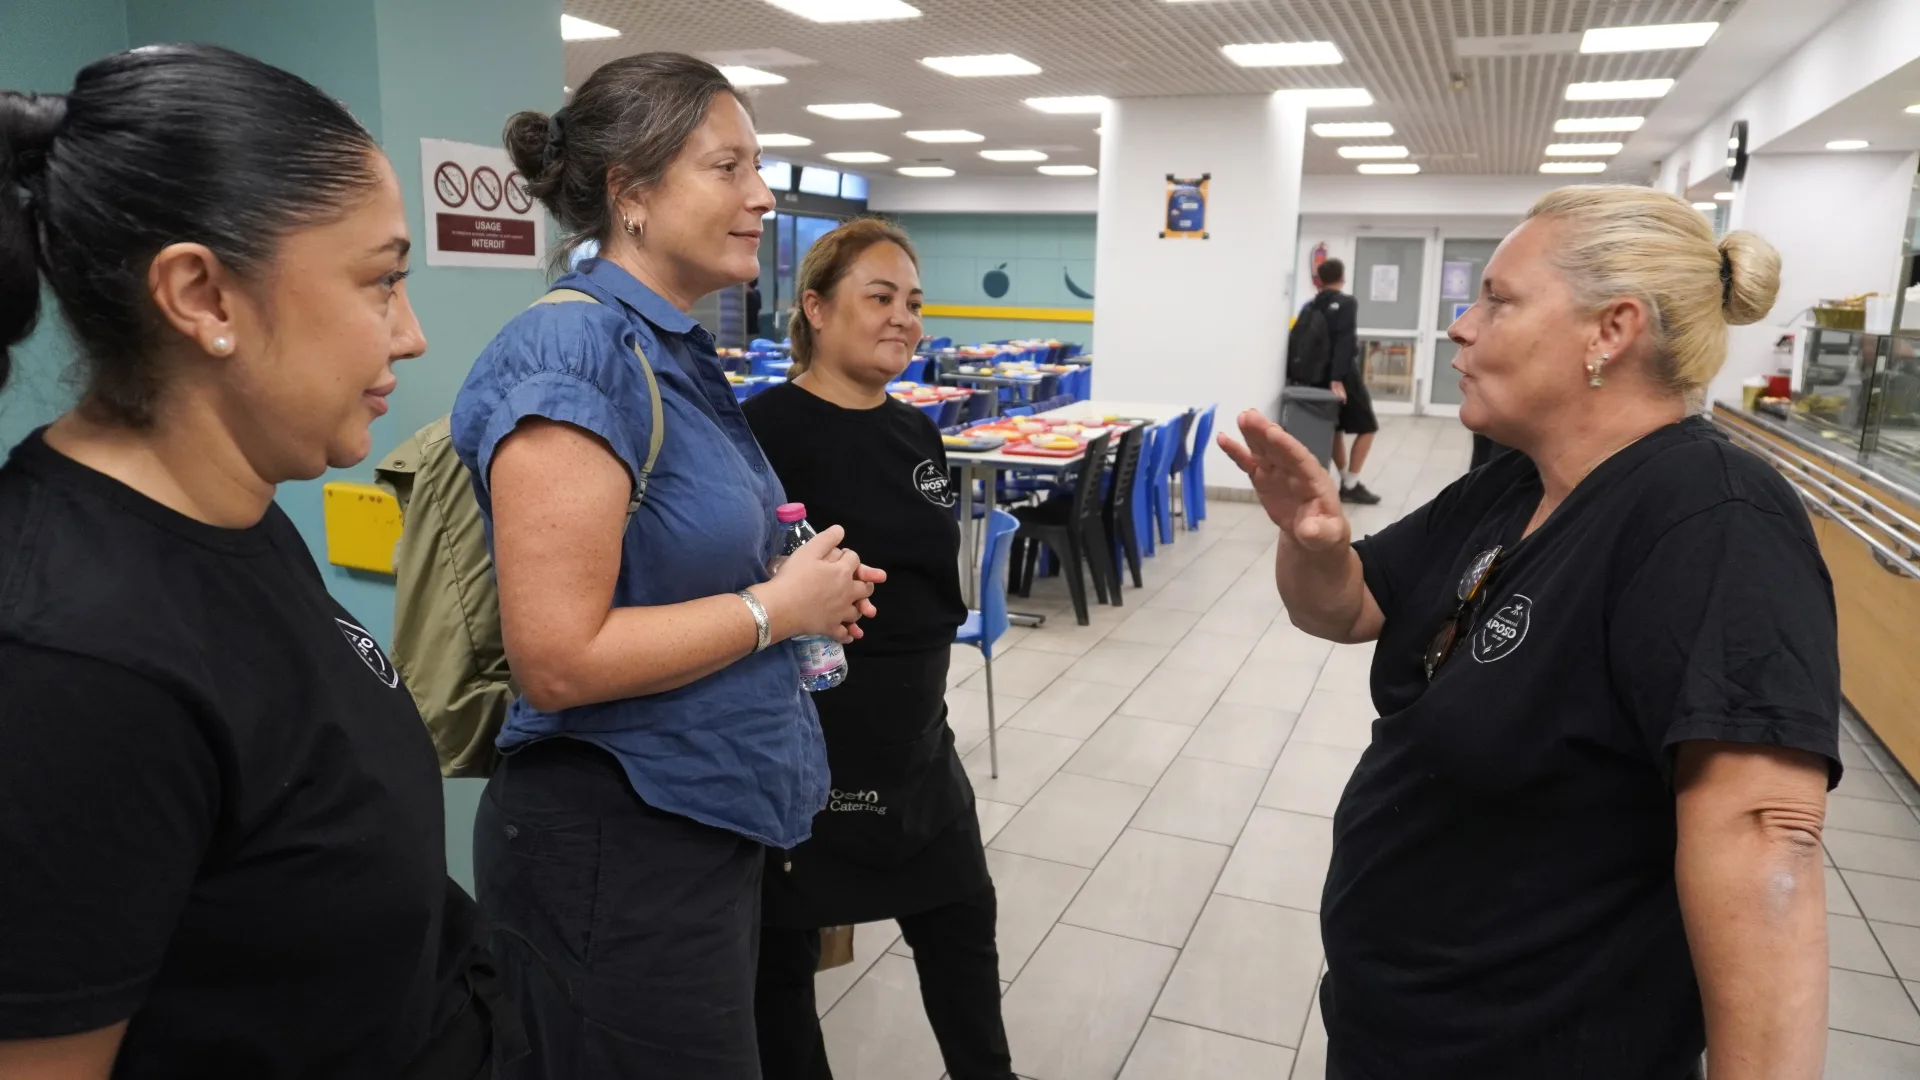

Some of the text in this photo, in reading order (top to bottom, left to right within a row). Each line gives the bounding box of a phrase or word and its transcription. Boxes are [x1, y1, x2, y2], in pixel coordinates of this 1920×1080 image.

[475, 220, 502, 231] USAGE
[471, 238, 506, 249] INTERDIT
[830, 800, 888, 816] Catering
